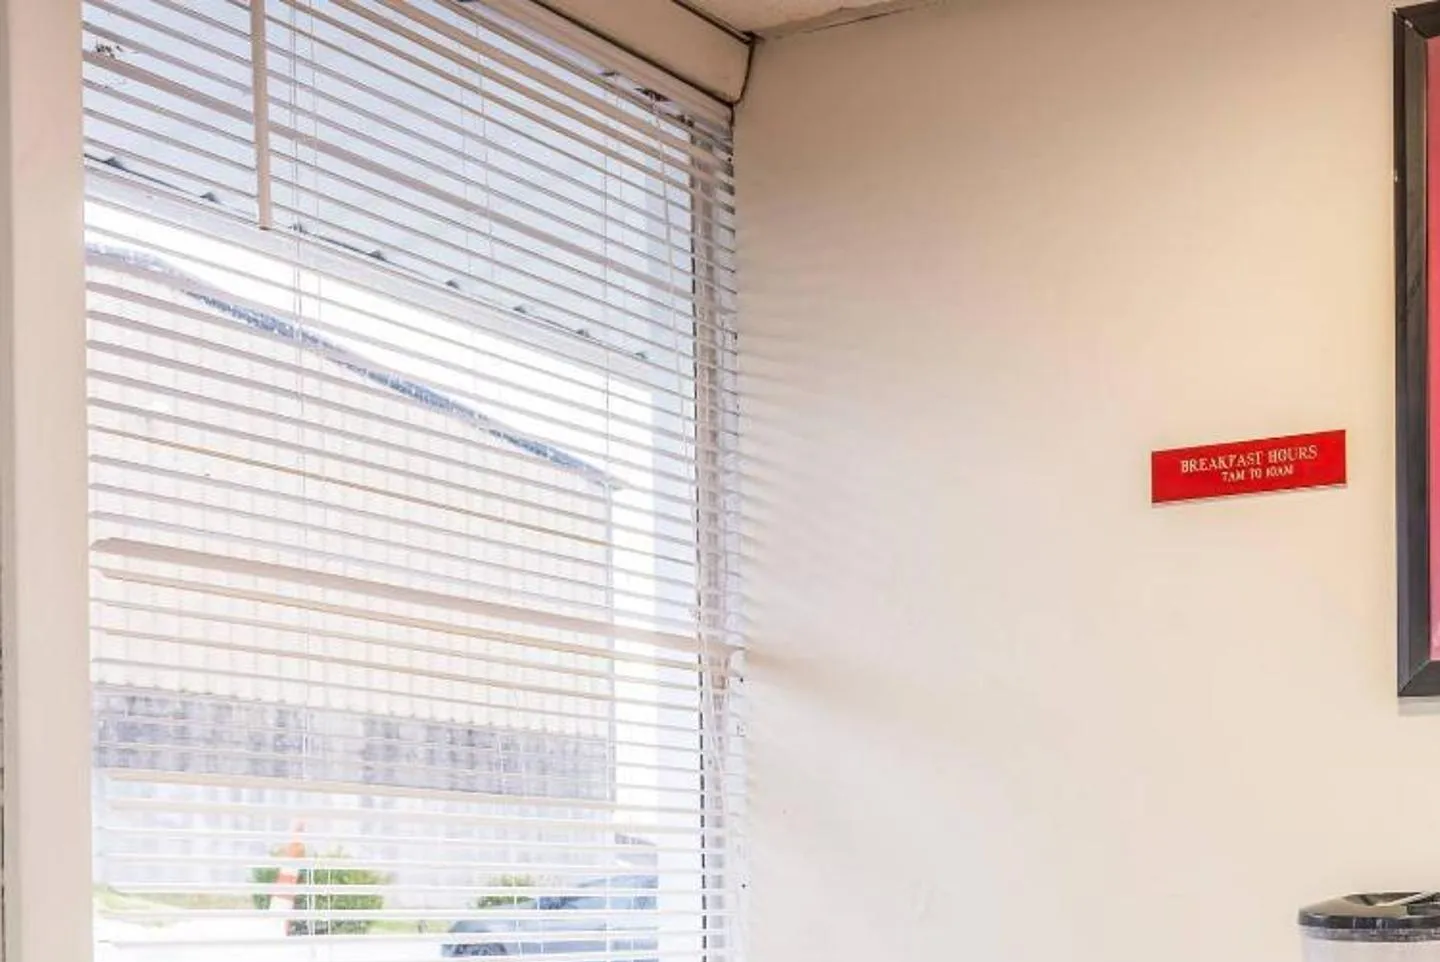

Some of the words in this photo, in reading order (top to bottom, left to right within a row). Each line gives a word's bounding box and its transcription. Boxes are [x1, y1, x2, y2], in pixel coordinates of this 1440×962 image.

[1181, 451, 1264, 472] BREAKFAST
[1268, 445, 1318, 463] HOURS
[1222, 471, 1245, 482] 7AM
[1250, 468, 1262, 479] TO
